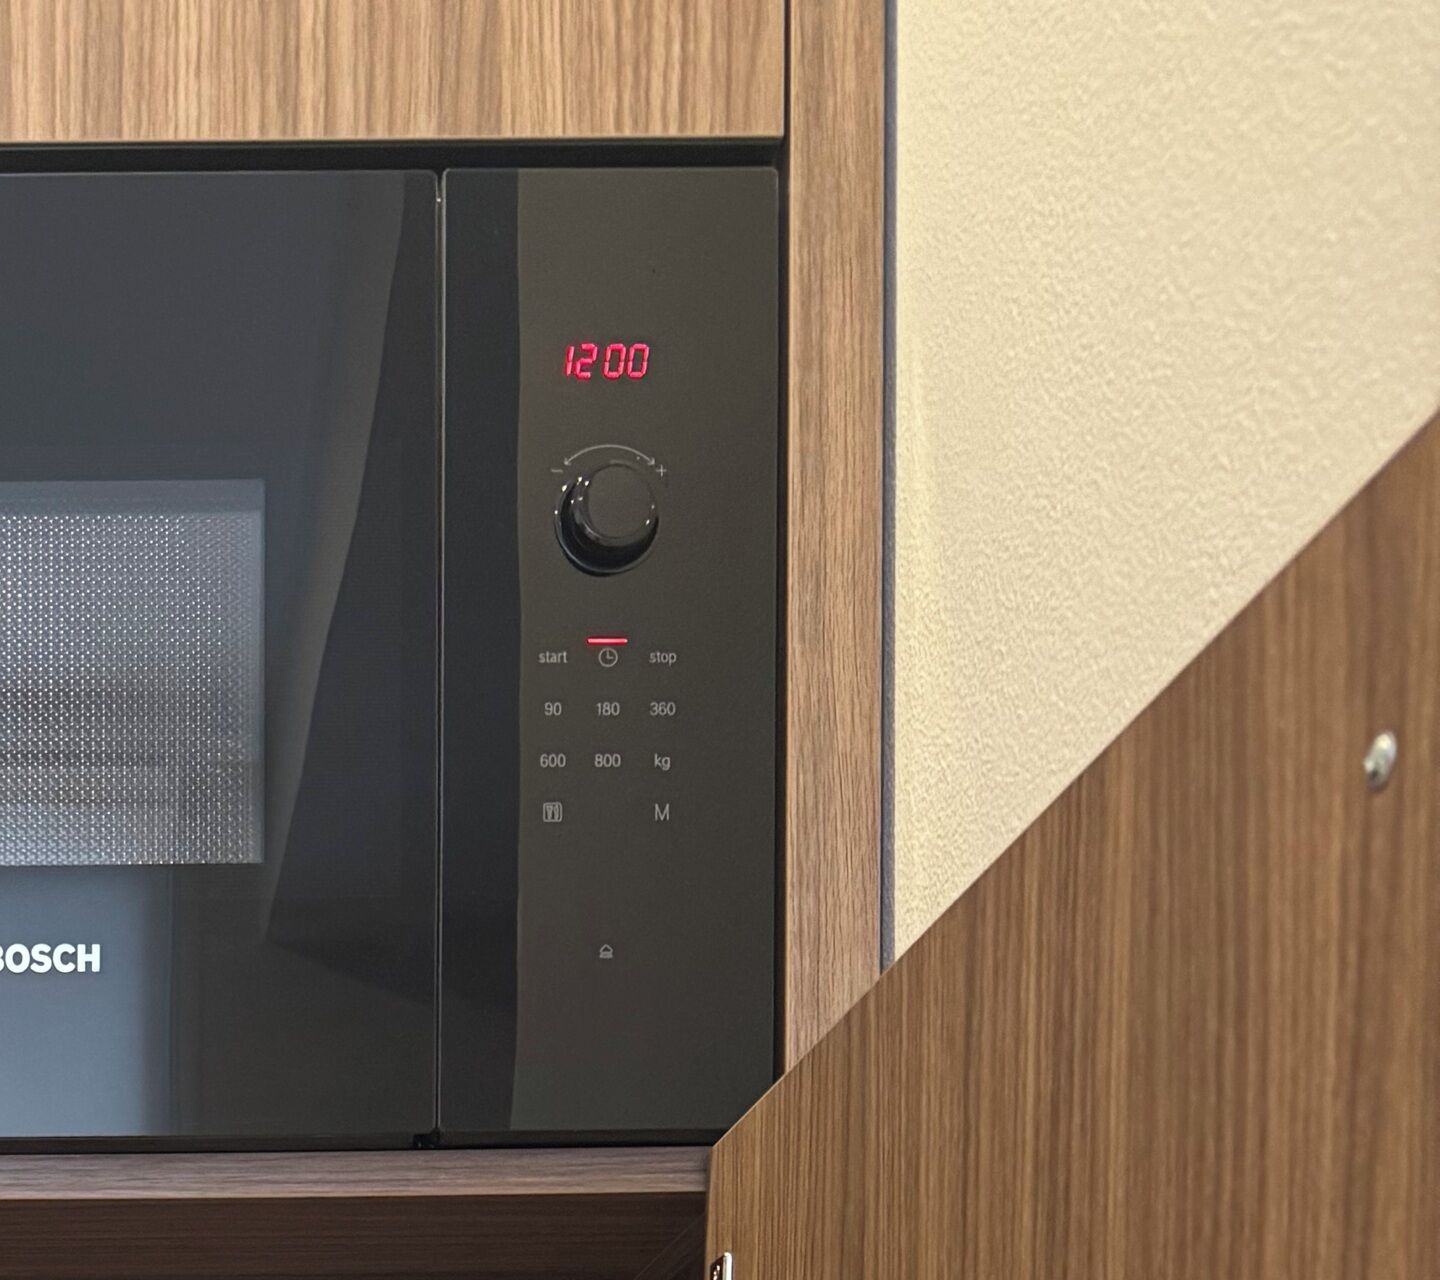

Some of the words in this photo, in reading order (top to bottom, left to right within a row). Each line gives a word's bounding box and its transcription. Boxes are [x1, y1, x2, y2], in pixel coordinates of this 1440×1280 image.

[538, 650, 568, 664] start
[649, 650, 677, 667] stop
[544, 702, 561, 716] 90
[596, 702, 620, 716] 180
[650, 702, 676, 716] 360
[540, 753, 566, 768] 600
[594, 753, 621, 768] 800
[654, 753, 671, 771] kg
[654, 803, 670, 821] M
